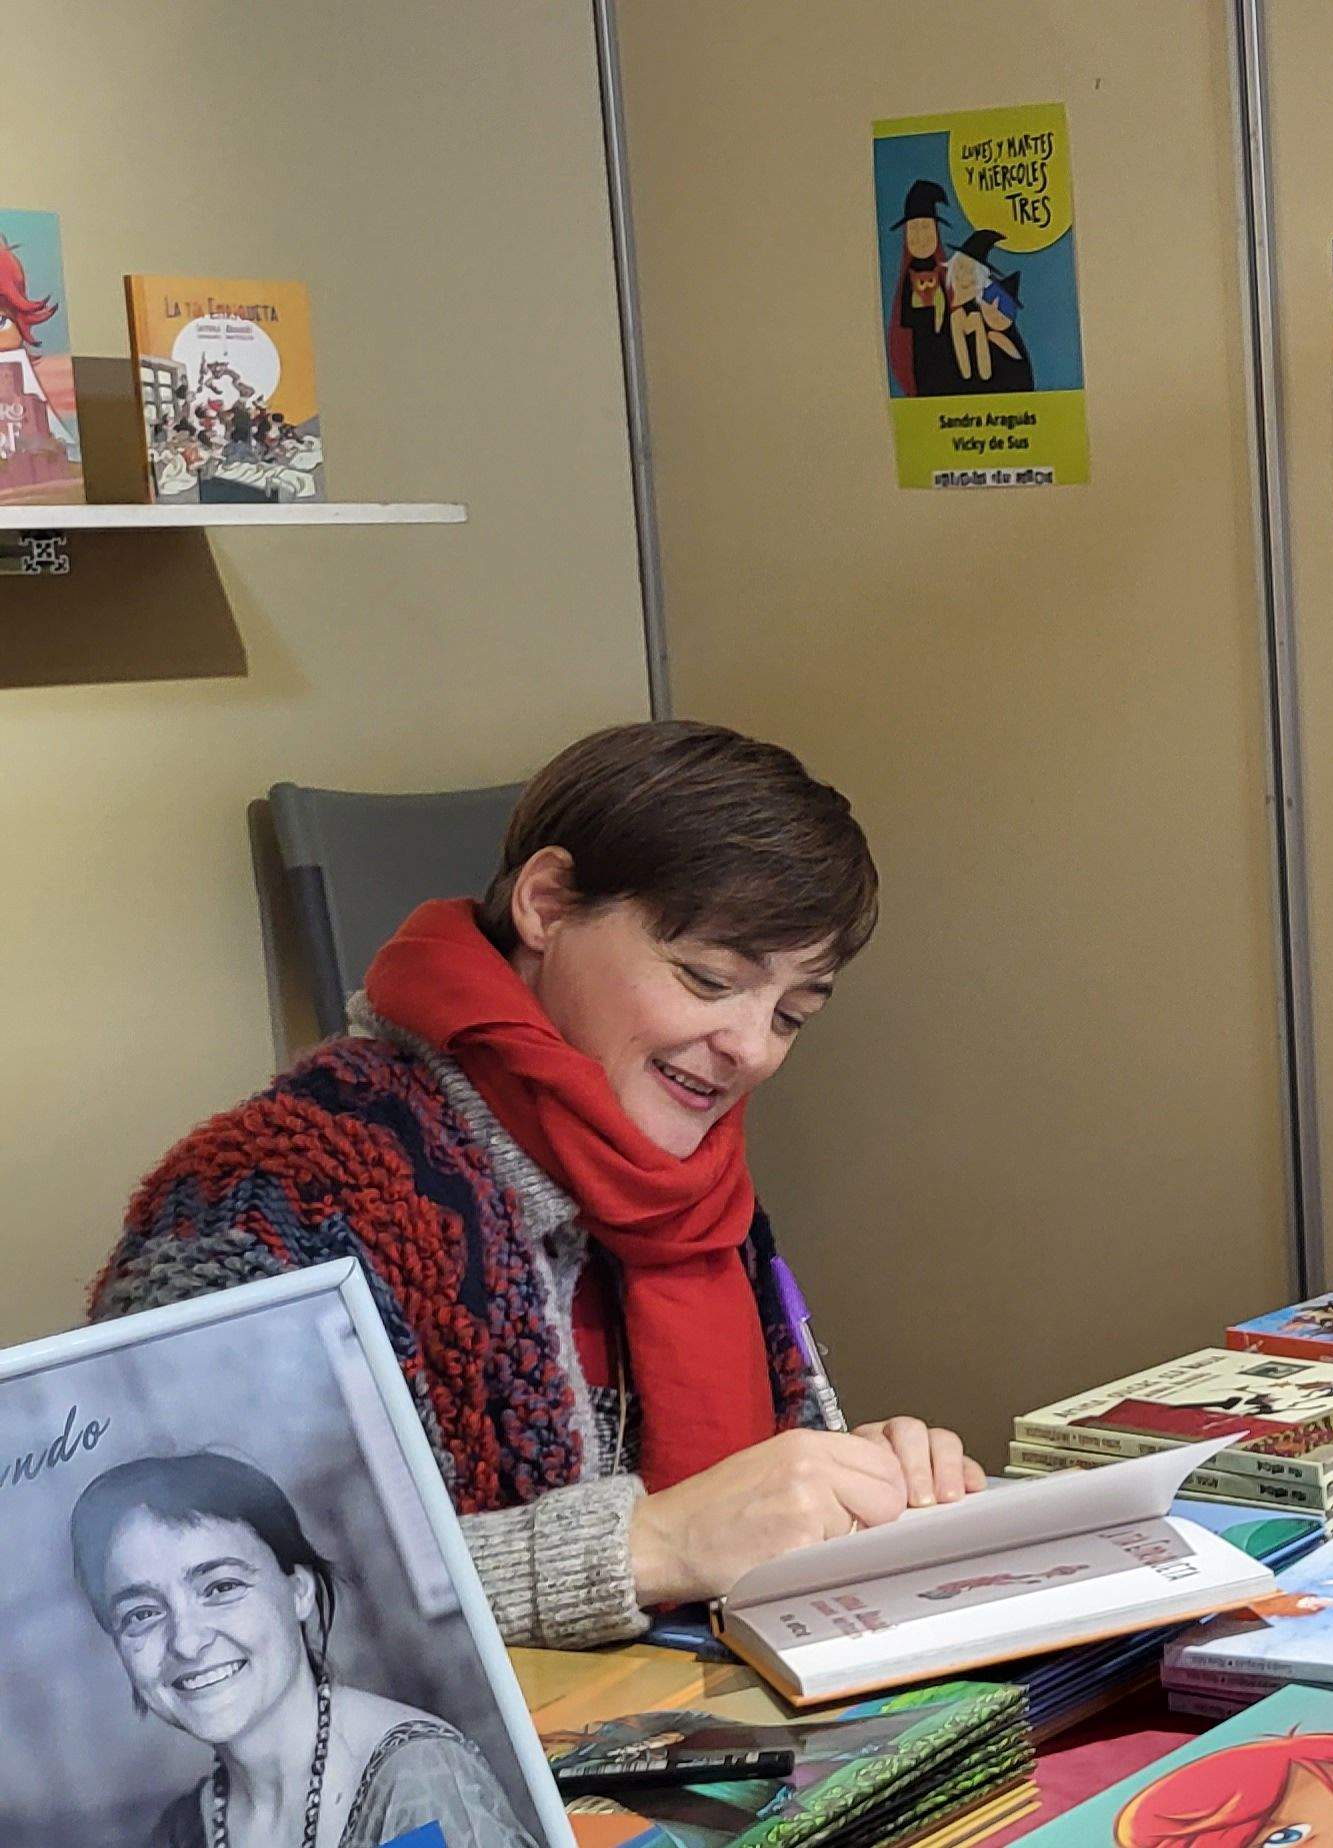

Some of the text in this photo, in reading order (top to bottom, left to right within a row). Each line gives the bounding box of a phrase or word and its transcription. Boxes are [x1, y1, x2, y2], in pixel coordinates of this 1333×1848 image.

[1007, 132, 1054, 159] MARTES
[966, 166, 975, 184] Y
[1006, 192, 1051, 228] TRES
[939, 415, 982, 429] Sandra
[953, 436, 1029, 454] Vicky de Sus
